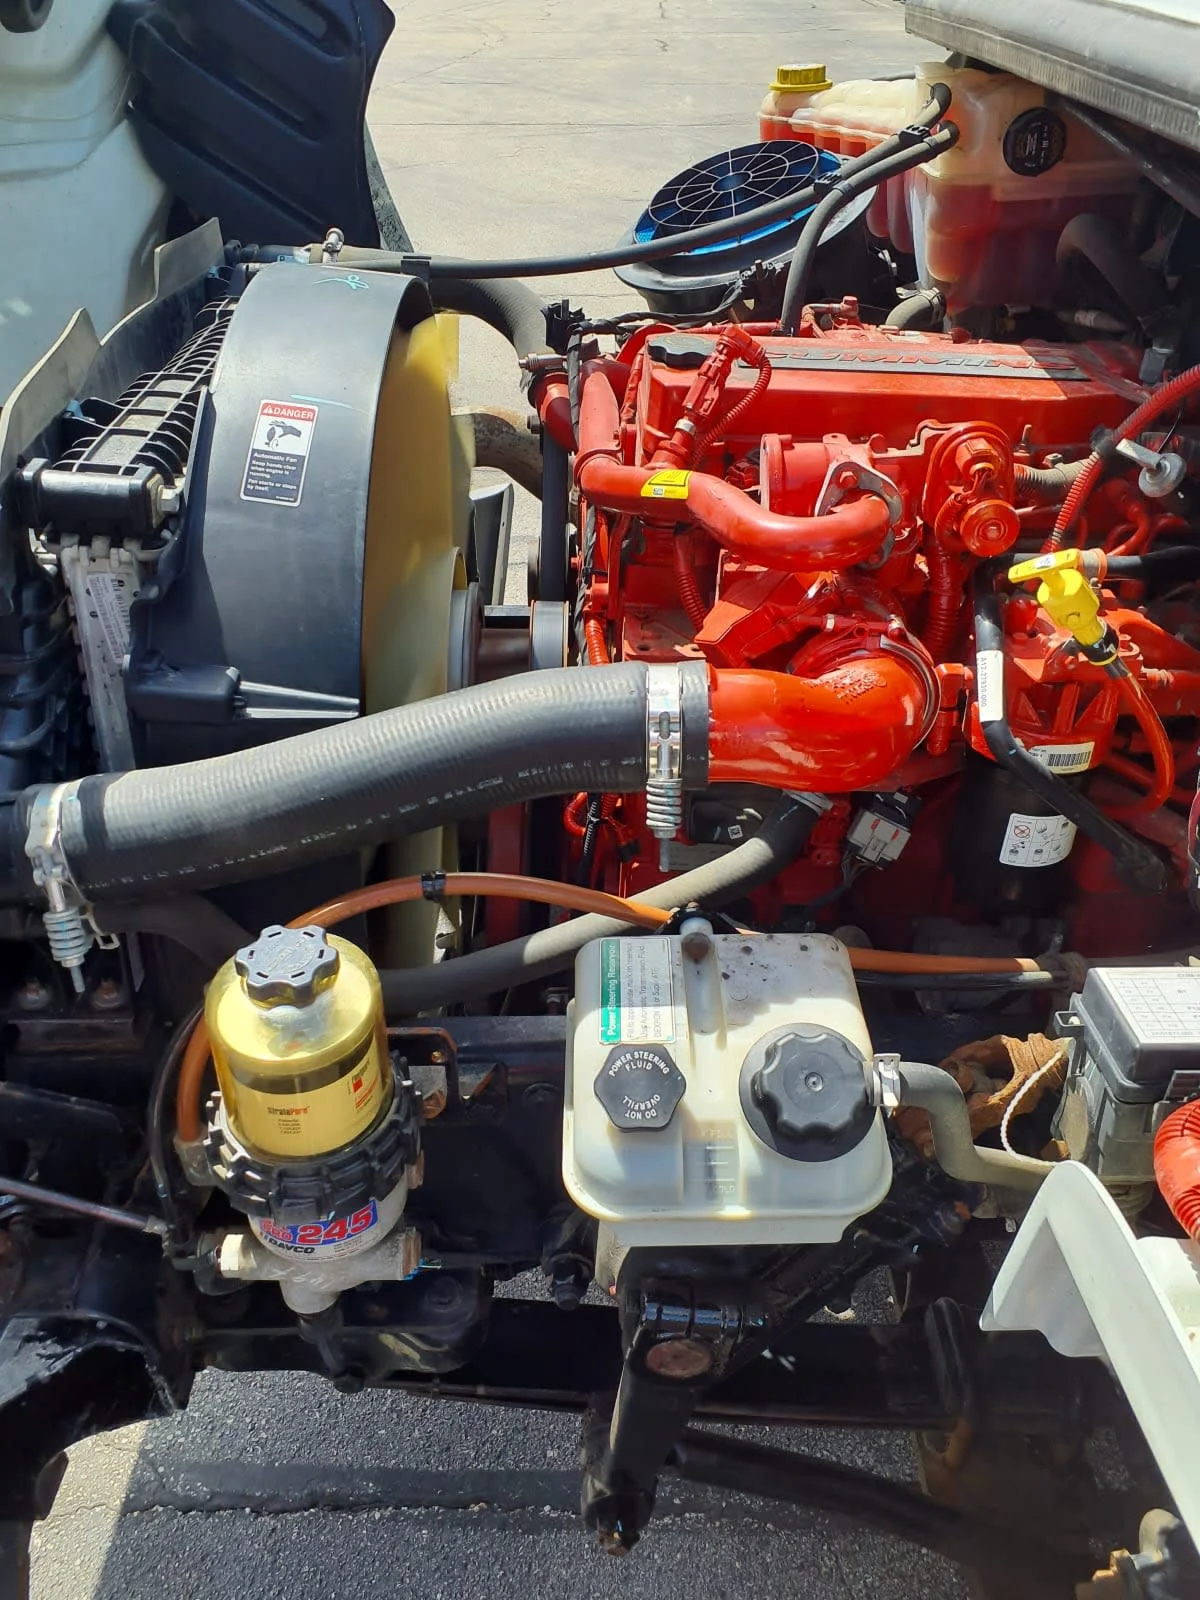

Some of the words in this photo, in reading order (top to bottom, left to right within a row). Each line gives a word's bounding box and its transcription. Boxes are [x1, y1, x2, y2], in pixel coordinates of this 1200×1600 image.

[273, 407, 314, 419] DANGER
[253, 452, 285, 462] Automatic
[606, 944, 617, 979] Reservoir
[606, 979, 619, 1010] Steering
[606, 1010, 617, 1036] Power
[608, 1052, 633, 1077] POWER
[633, 1051, 670, 1075] STEERING
[625, 1060, 653, 1072] FLUID
[622, 1094, 661, 1110] OVERFILL
[624, 1109, 642, 1119] NOT
[645, 1108, 657, 1119] DO
[296, 1203, 373, 1246] 245
[268, 1237, 316, 1254] DAVCO
